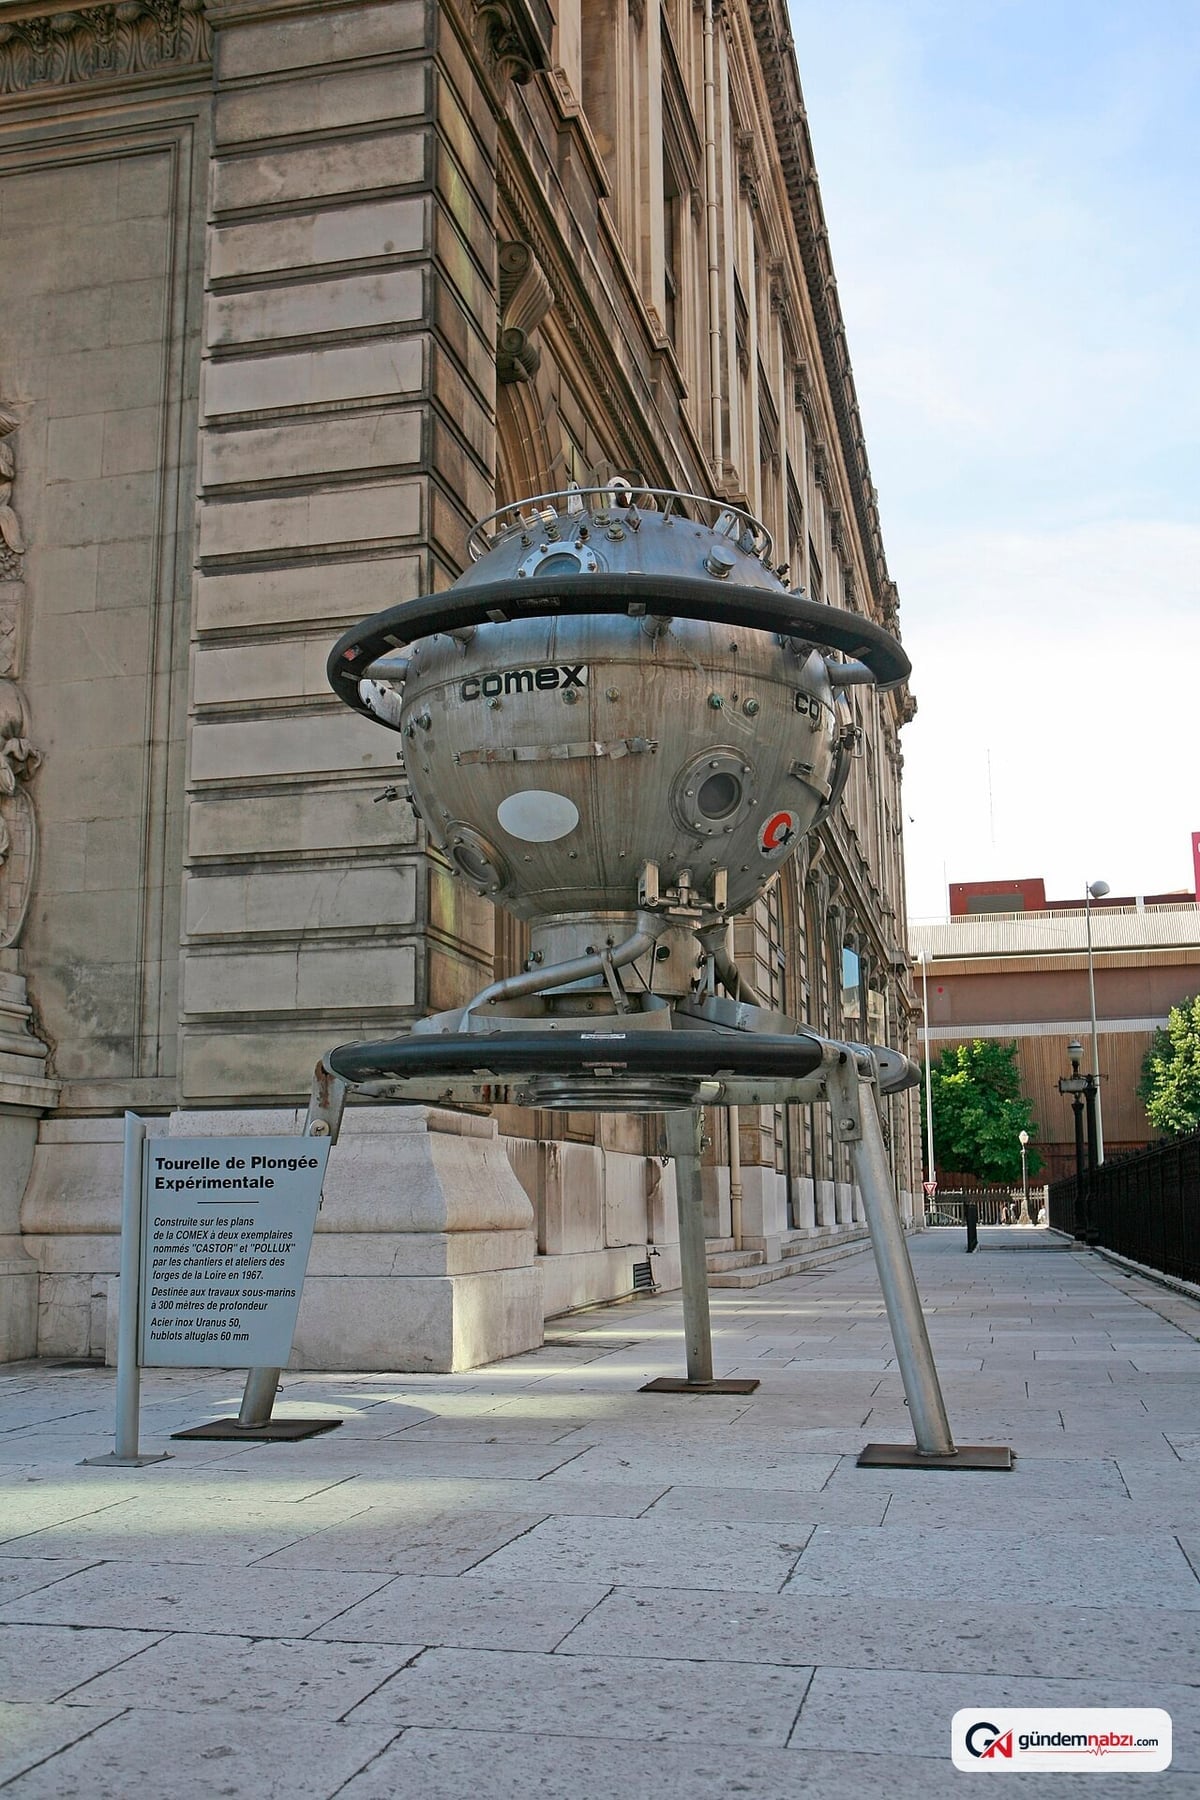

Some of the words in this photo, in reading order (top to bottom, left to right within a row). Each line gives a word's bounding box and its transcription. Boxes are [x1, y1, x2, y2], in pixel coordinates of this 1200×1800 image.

[461, 665, 585, 701] comex
[155, 1156, 220, 1170] Tourelle
[225, 1156, 245, 1169] de
[251, 1155, 318, 1171] Plongée
[155, 1175, 275, 1192] Expérimentale
[154, 1216, 198, 1227] Construite
[200, 1218, 214, 1226] sur
[215, 1217, 228, 1226] les
[230, 1217, 255, 1228] plans
[153, 1230, 164, 1240] de
[166, 1230, 173, 1240] la
[176, 1230, 209, 1240] COMEX
[210, 1230, 216, 1240] à
[217, 1230, 239, 1240] deux
[240, 1230, 293, 1241] exemplaires
[153, 1243, 189, 1253] nommés
[192, 1243, 238, 1253] "CASTOR"
[239, 1244, 248, 1253] et
[250, 1243, 296, 1253] "POLLUX"
[152, 1258, 167, 1268] par
[168, 1257, 181, 1266] les
[183, 1257, 223, 1266] chantiers
[225, 1257, 234, 1266] et
[235, 1257, 267, 1266] ateliers
[269, 1257, 285, 1266] des
[152, 1270, 180, 1282] forges
[182, 1270, 192, 1279] de
[194, 1270, 202, 1279] la
[204, 1270, 226, 1280] Loire
[242, 1270, 263, 1280] 1967.
[151, 1286, 188, 1297] Destinée
[190, 1288, 206, 1297] aux
[208, 1287, 240, 1297] travaux
[241, 1287, 296, 1297] sous-marins
[151, 1300, 157, 1310] à
[158, 1300, 174, 1310] 300
[175, 1300, 205, 1310] mètres
[206, 1300, 218, 1310] de
[219, 1301, 268, 1312] profondeur
[150, 1317, 173, 1327] Acier
[175, 1317, 194, 1327] inox
[196, 1317, 227, 1327] Uranus
[228, 1317, 240, 1328] 50,
[150, 1330, 182, 1340] hublots
[184, 1330, 218, 1343] altuglas
[220, 1331, 231, 1341] 60
[232, 1333, 249, 1341] mm
